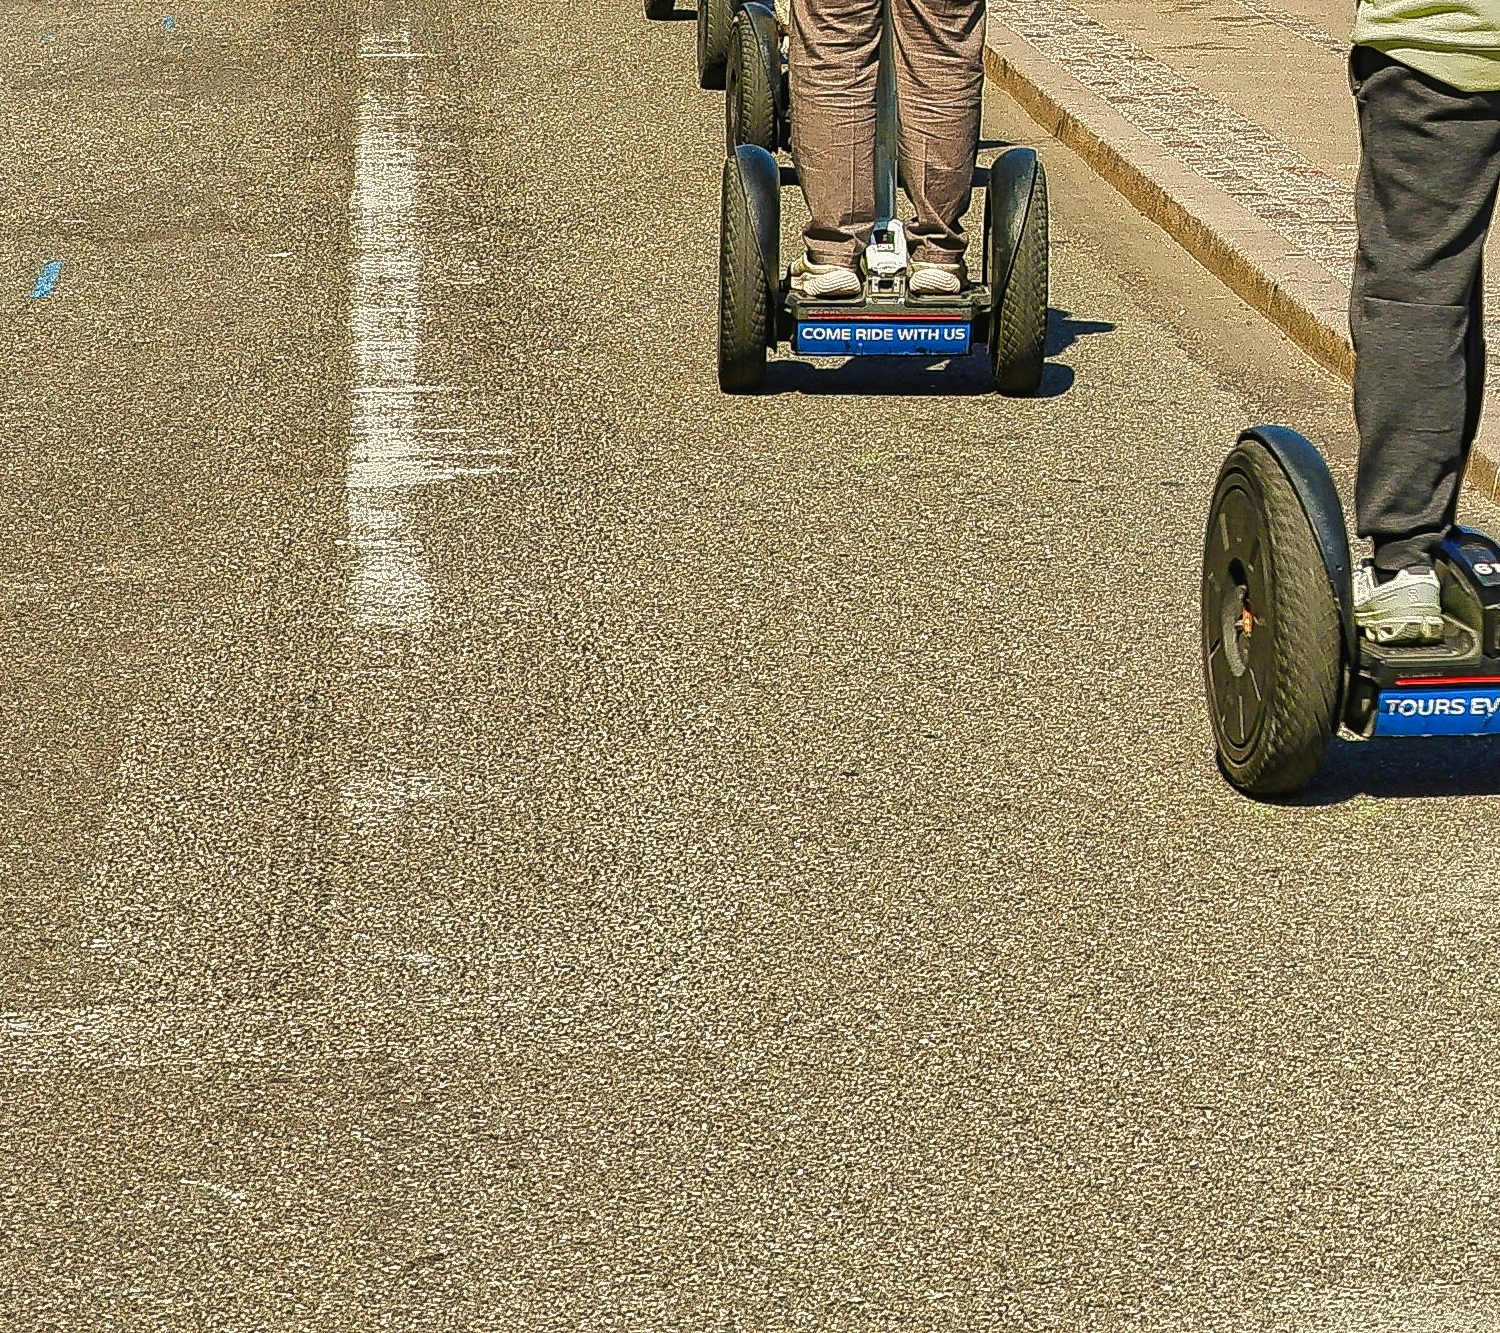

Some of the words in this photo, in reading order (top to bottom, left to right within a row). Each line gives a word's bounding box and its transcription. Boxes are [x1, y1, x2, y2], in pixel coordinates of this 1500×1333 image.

[802, 327, 851, 342] COME
[855, 328, 893, 342] RIDE
[897, 328, 940, 341] WITH
[943, 328, 966, 341] US
[1385, 698, 1466, 717] TOURS
